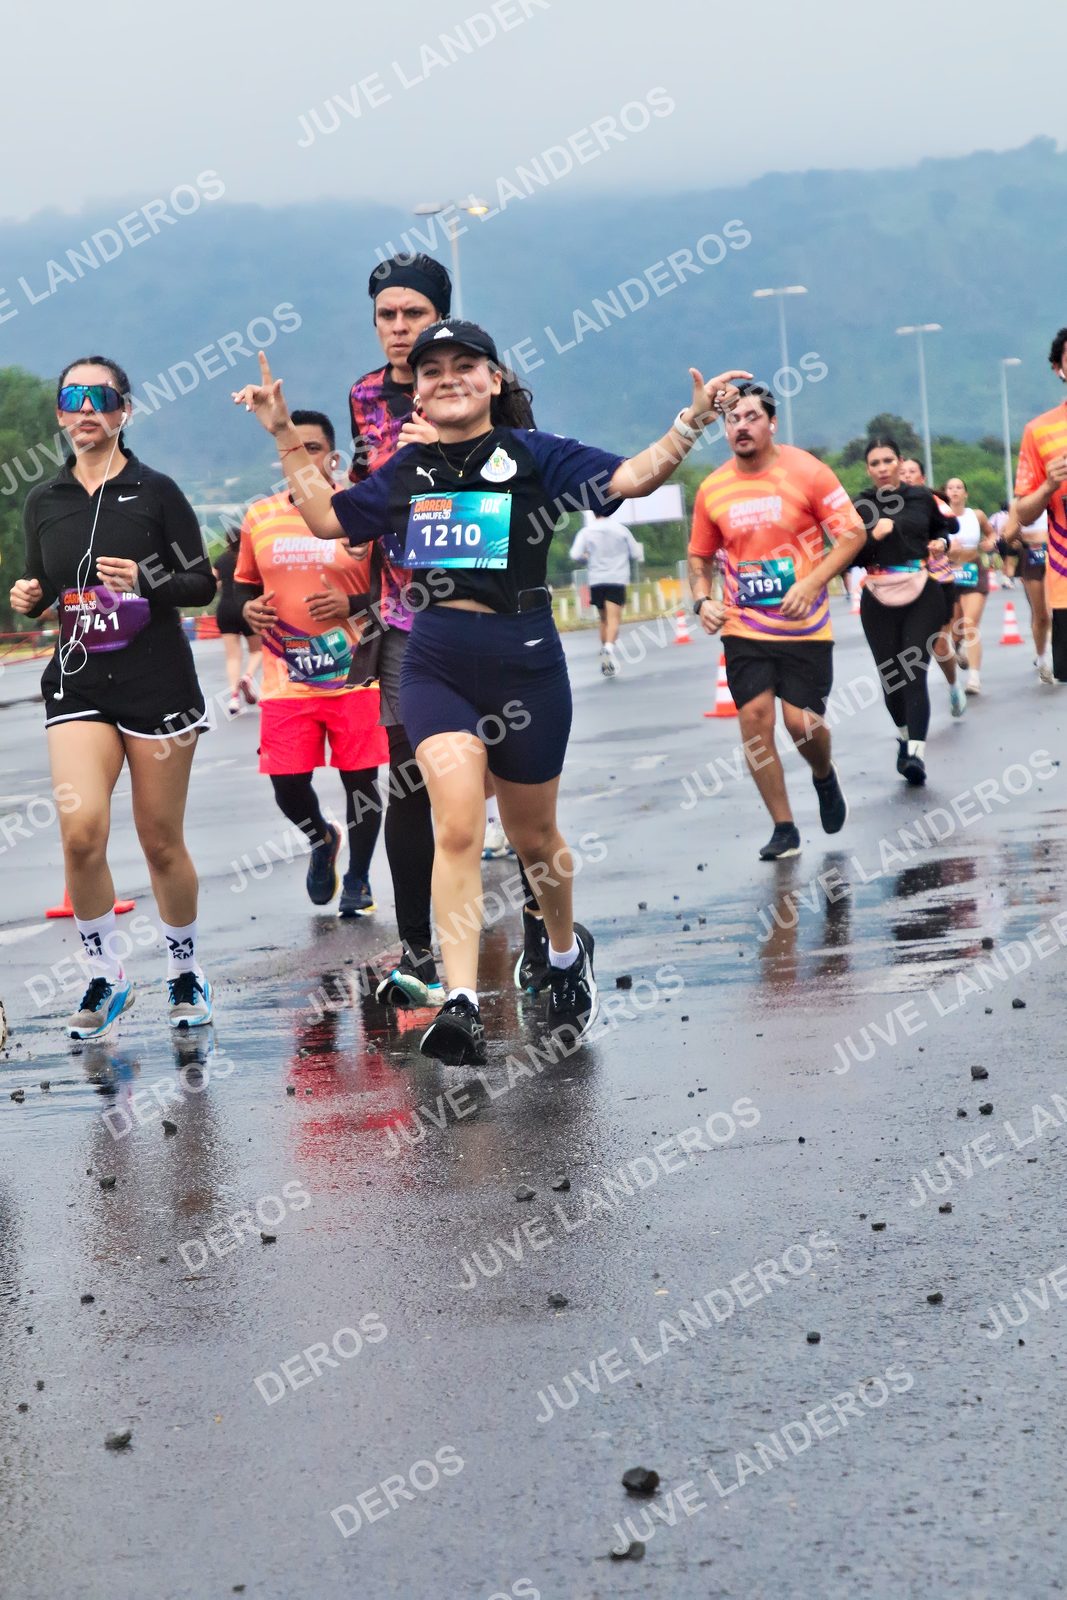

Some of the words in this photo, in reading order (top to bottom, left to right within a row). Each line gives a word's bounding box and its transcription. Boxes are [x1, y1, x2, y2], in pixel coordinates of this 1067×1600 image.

[413, 498, 453, 512] CARRERA
[480, 498, 501, 513] 10K
[421, 524, 481, 546] 1210
[747, 577, 783, 593] 1191
[81, 612, 119, 633] 741
[295, 653, 335, 670] 1174
